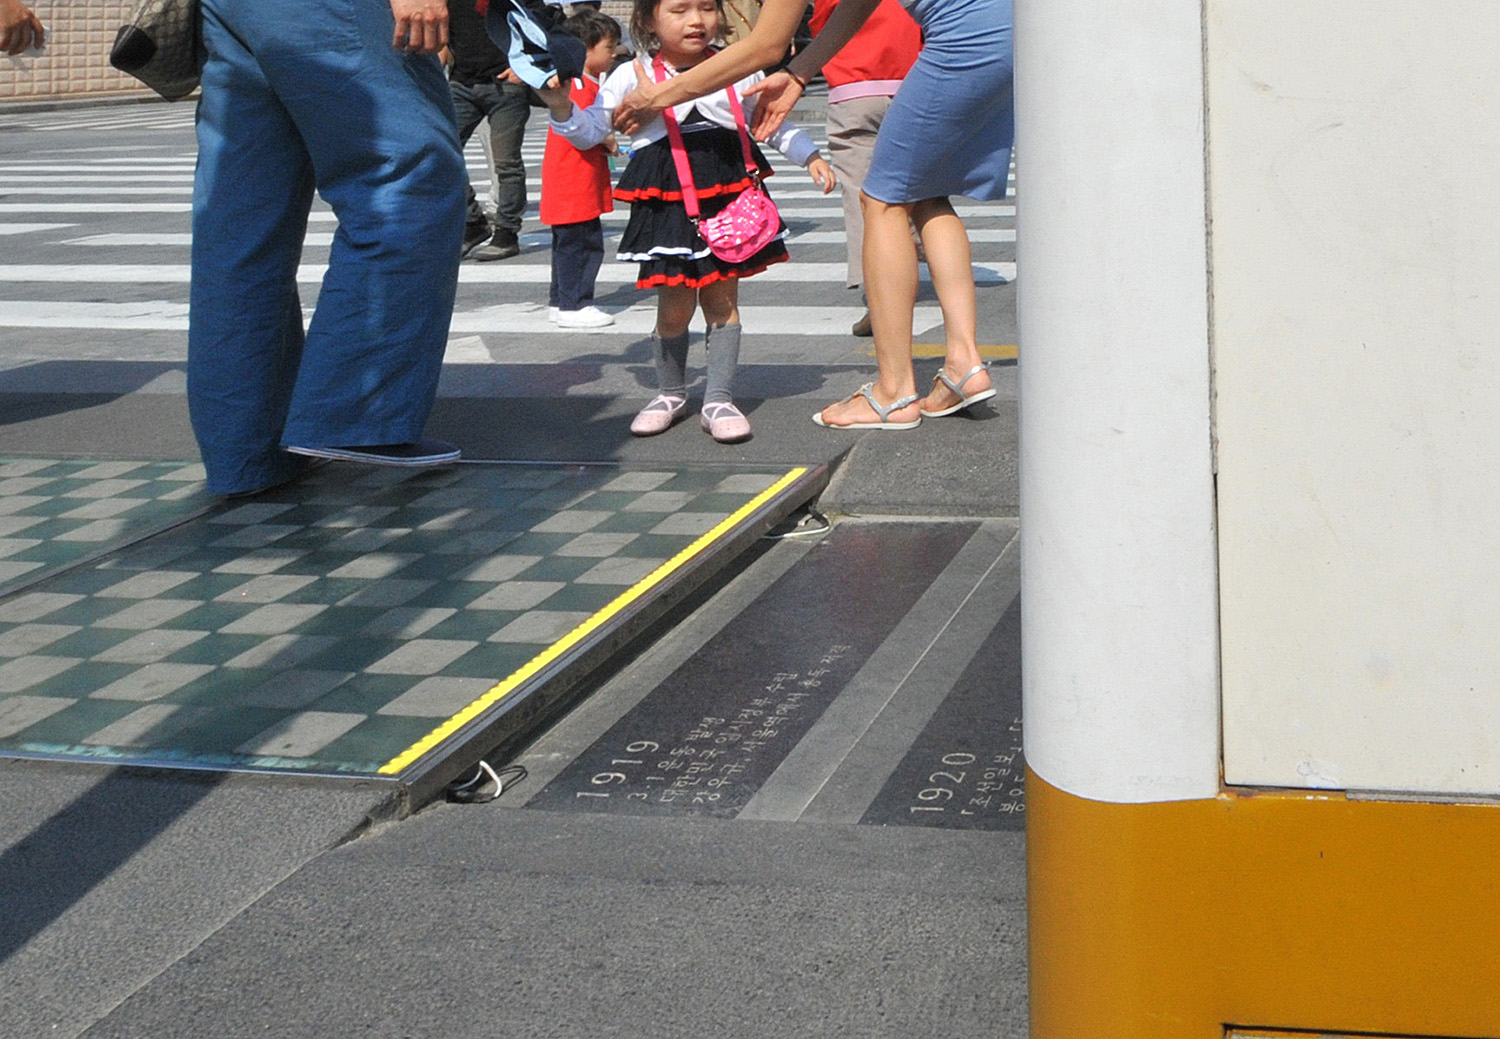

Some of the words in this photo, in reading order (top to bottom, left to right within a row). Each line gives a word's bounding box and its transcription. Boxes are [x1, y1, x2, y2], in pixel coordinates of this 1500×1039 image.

[657, 745, 696, 771] 운동
[685, 716, 725, 740] 발생
[659, 749, 727, 802] 대한민국
[715, 697, 772, 744] 임시정부
[765, 672, 798, 692] 수립
[742, 693, 810, 752] 서울역에서
[576, 740, 659, 798] 1919
[910, 752, 976, 814] 1920
